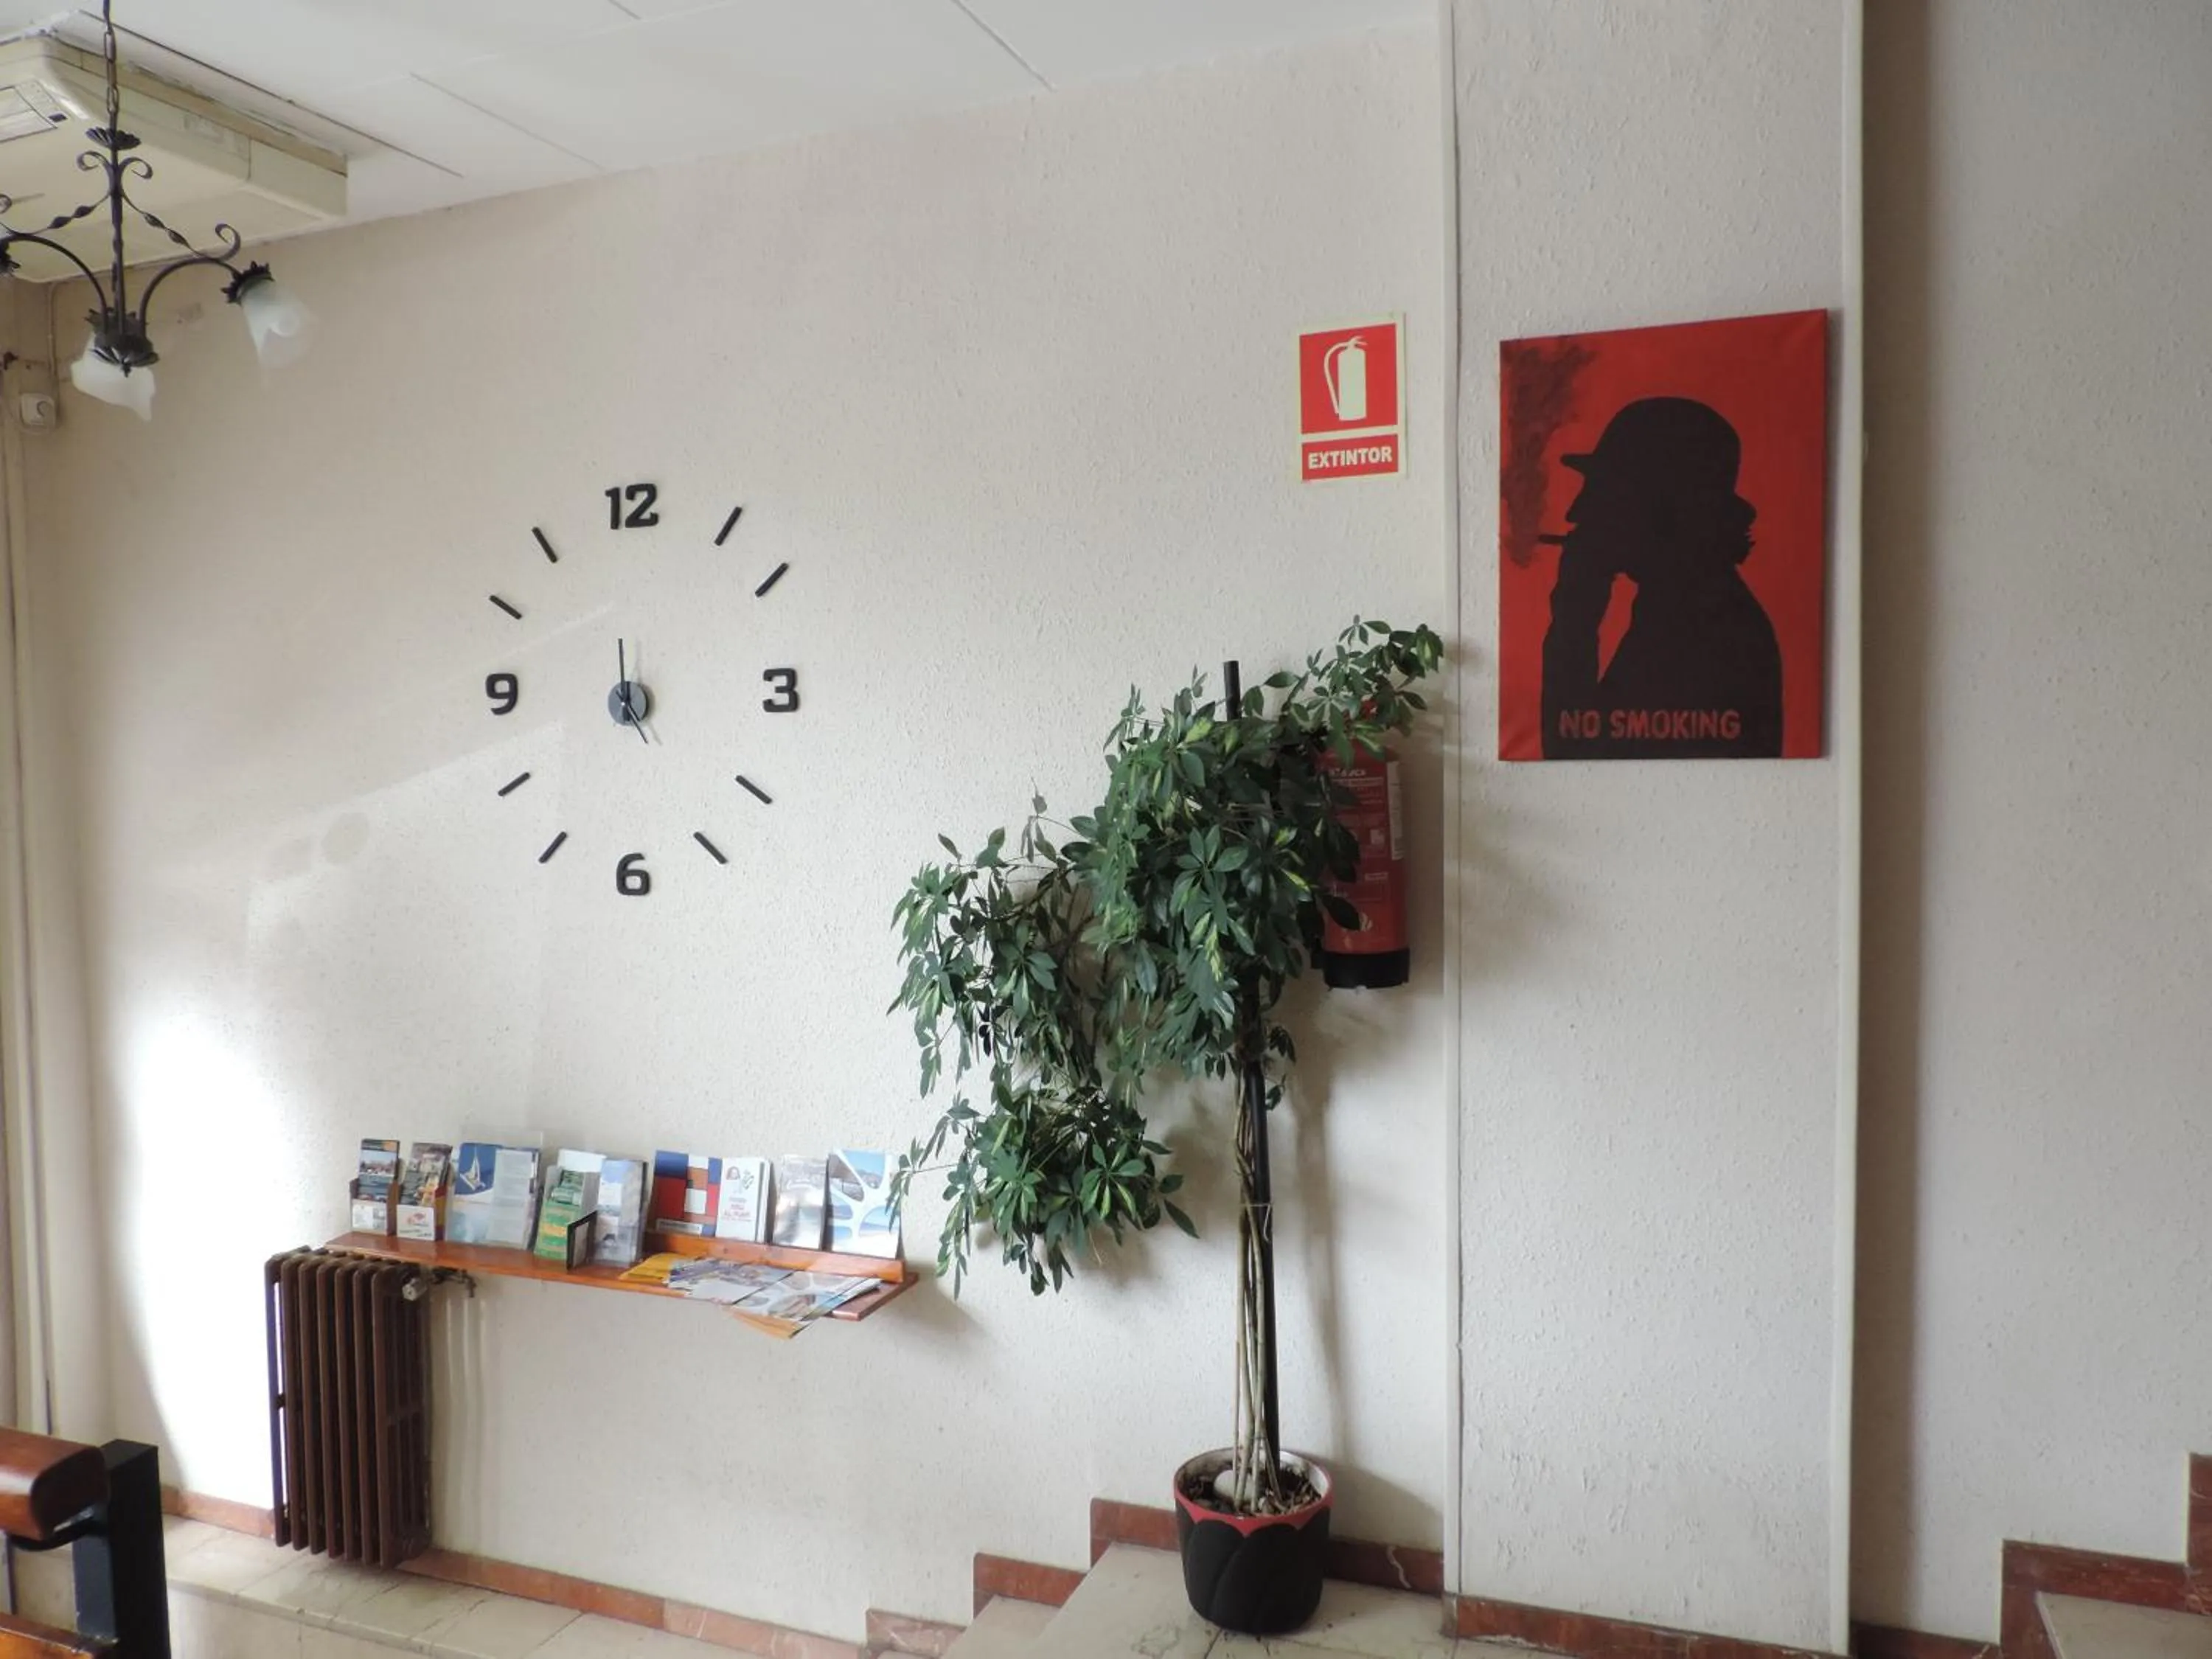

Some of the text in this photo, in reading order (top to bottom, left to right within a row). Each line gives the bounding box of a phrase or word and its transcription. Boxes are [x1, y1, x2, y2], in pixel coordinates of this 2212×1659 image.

[1308, 445, 1392, 469] EXTINTOR
[605, 483, 659, 529] 12
[486, 672, 518, 715] 9
[762, 667, 799, 713] 3
[1559, 709, 1742, 739] NO SMOKING
[616, 853, 651, 896] 6
